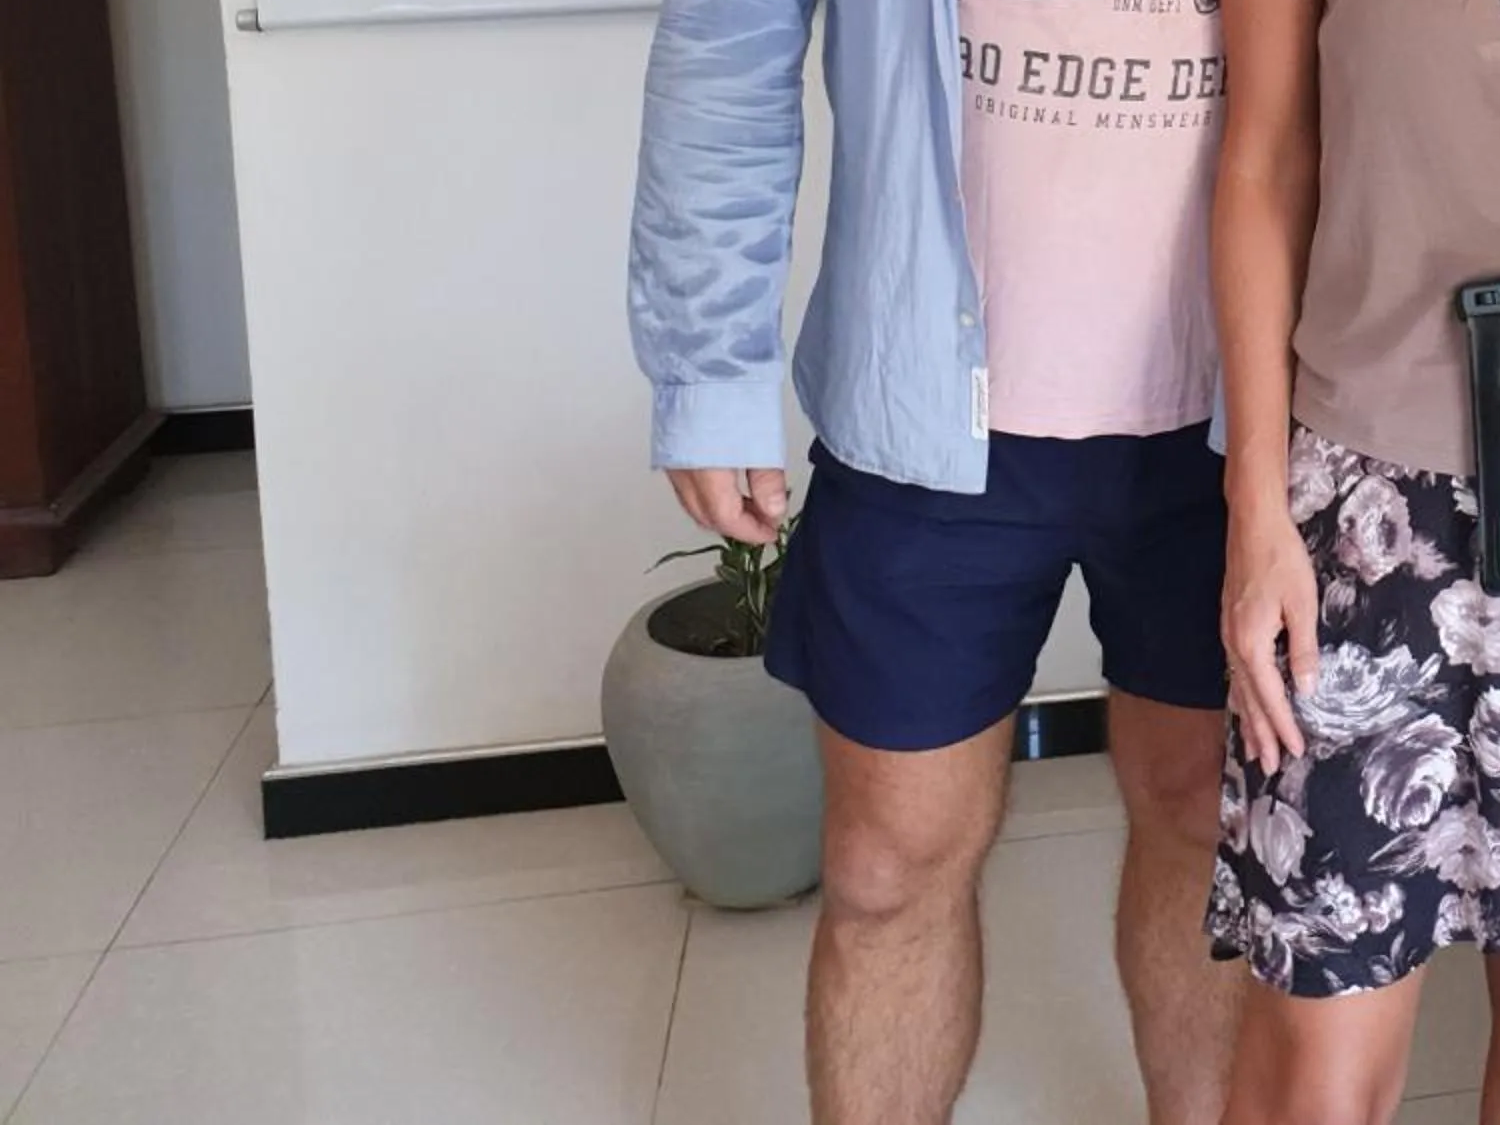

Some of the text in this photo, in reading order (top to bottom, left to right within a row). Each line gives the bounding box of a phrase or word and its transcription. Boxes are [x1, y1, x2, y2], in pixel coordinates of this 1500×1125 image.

[1017, 49, 1152, 102] EDGE
[1167, 56, 1229, 102] DE
[974, 93, 1215, 130] ORIGINAL MENSWEAR
